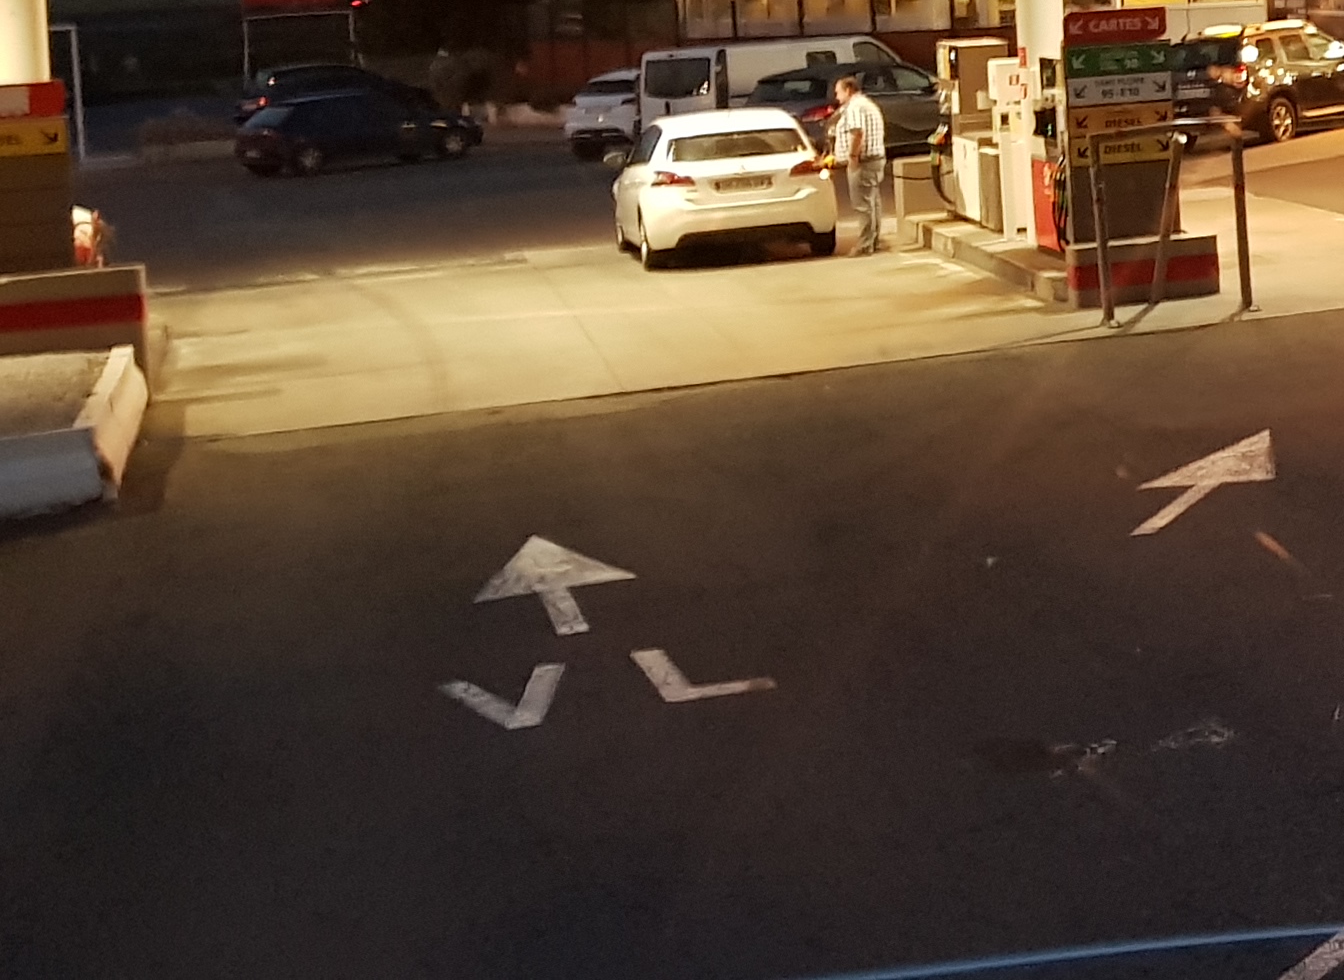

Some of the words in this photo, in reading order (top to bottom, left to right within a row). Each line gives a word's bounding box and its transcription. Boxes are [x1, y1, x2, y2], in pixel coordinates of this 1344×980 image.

[1089, 18, 1142, 32] CARTES
[1104, 118, 1142, 128] DIESEL
[1103, 142, 1143, 155] DIESEL
